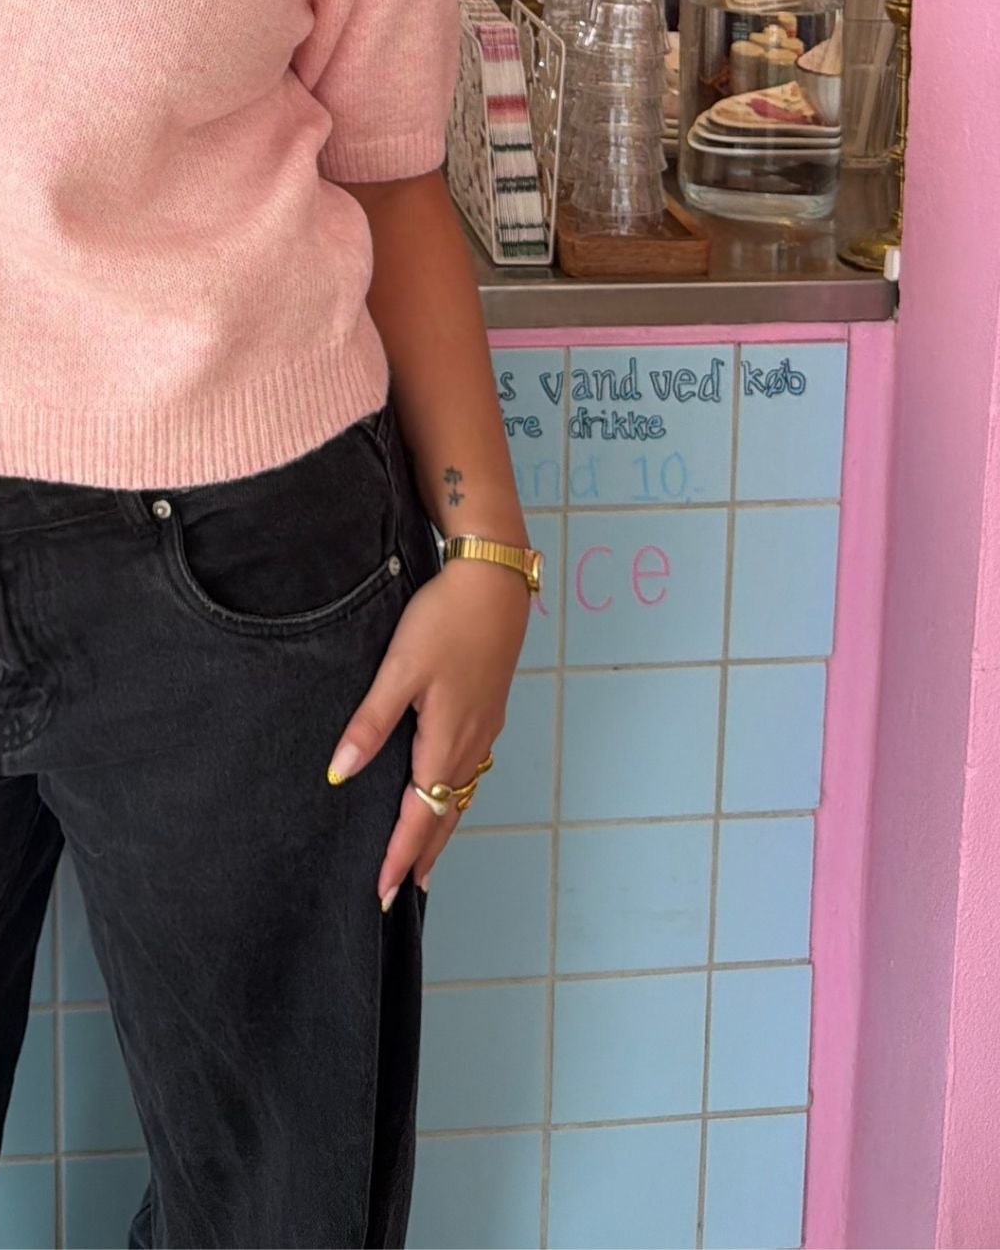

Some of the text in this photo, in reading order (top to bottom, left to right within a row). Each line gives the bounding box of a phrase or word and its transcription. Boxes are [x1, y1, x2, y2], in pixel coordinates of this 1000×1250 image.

[539, 357, 642, 405] vand
[649, 358, 724, 403] ved
[740, 357, 806, 398] køb
[500, 407, 667, 441] re drikke
[531, 544, 671, 618] ce
